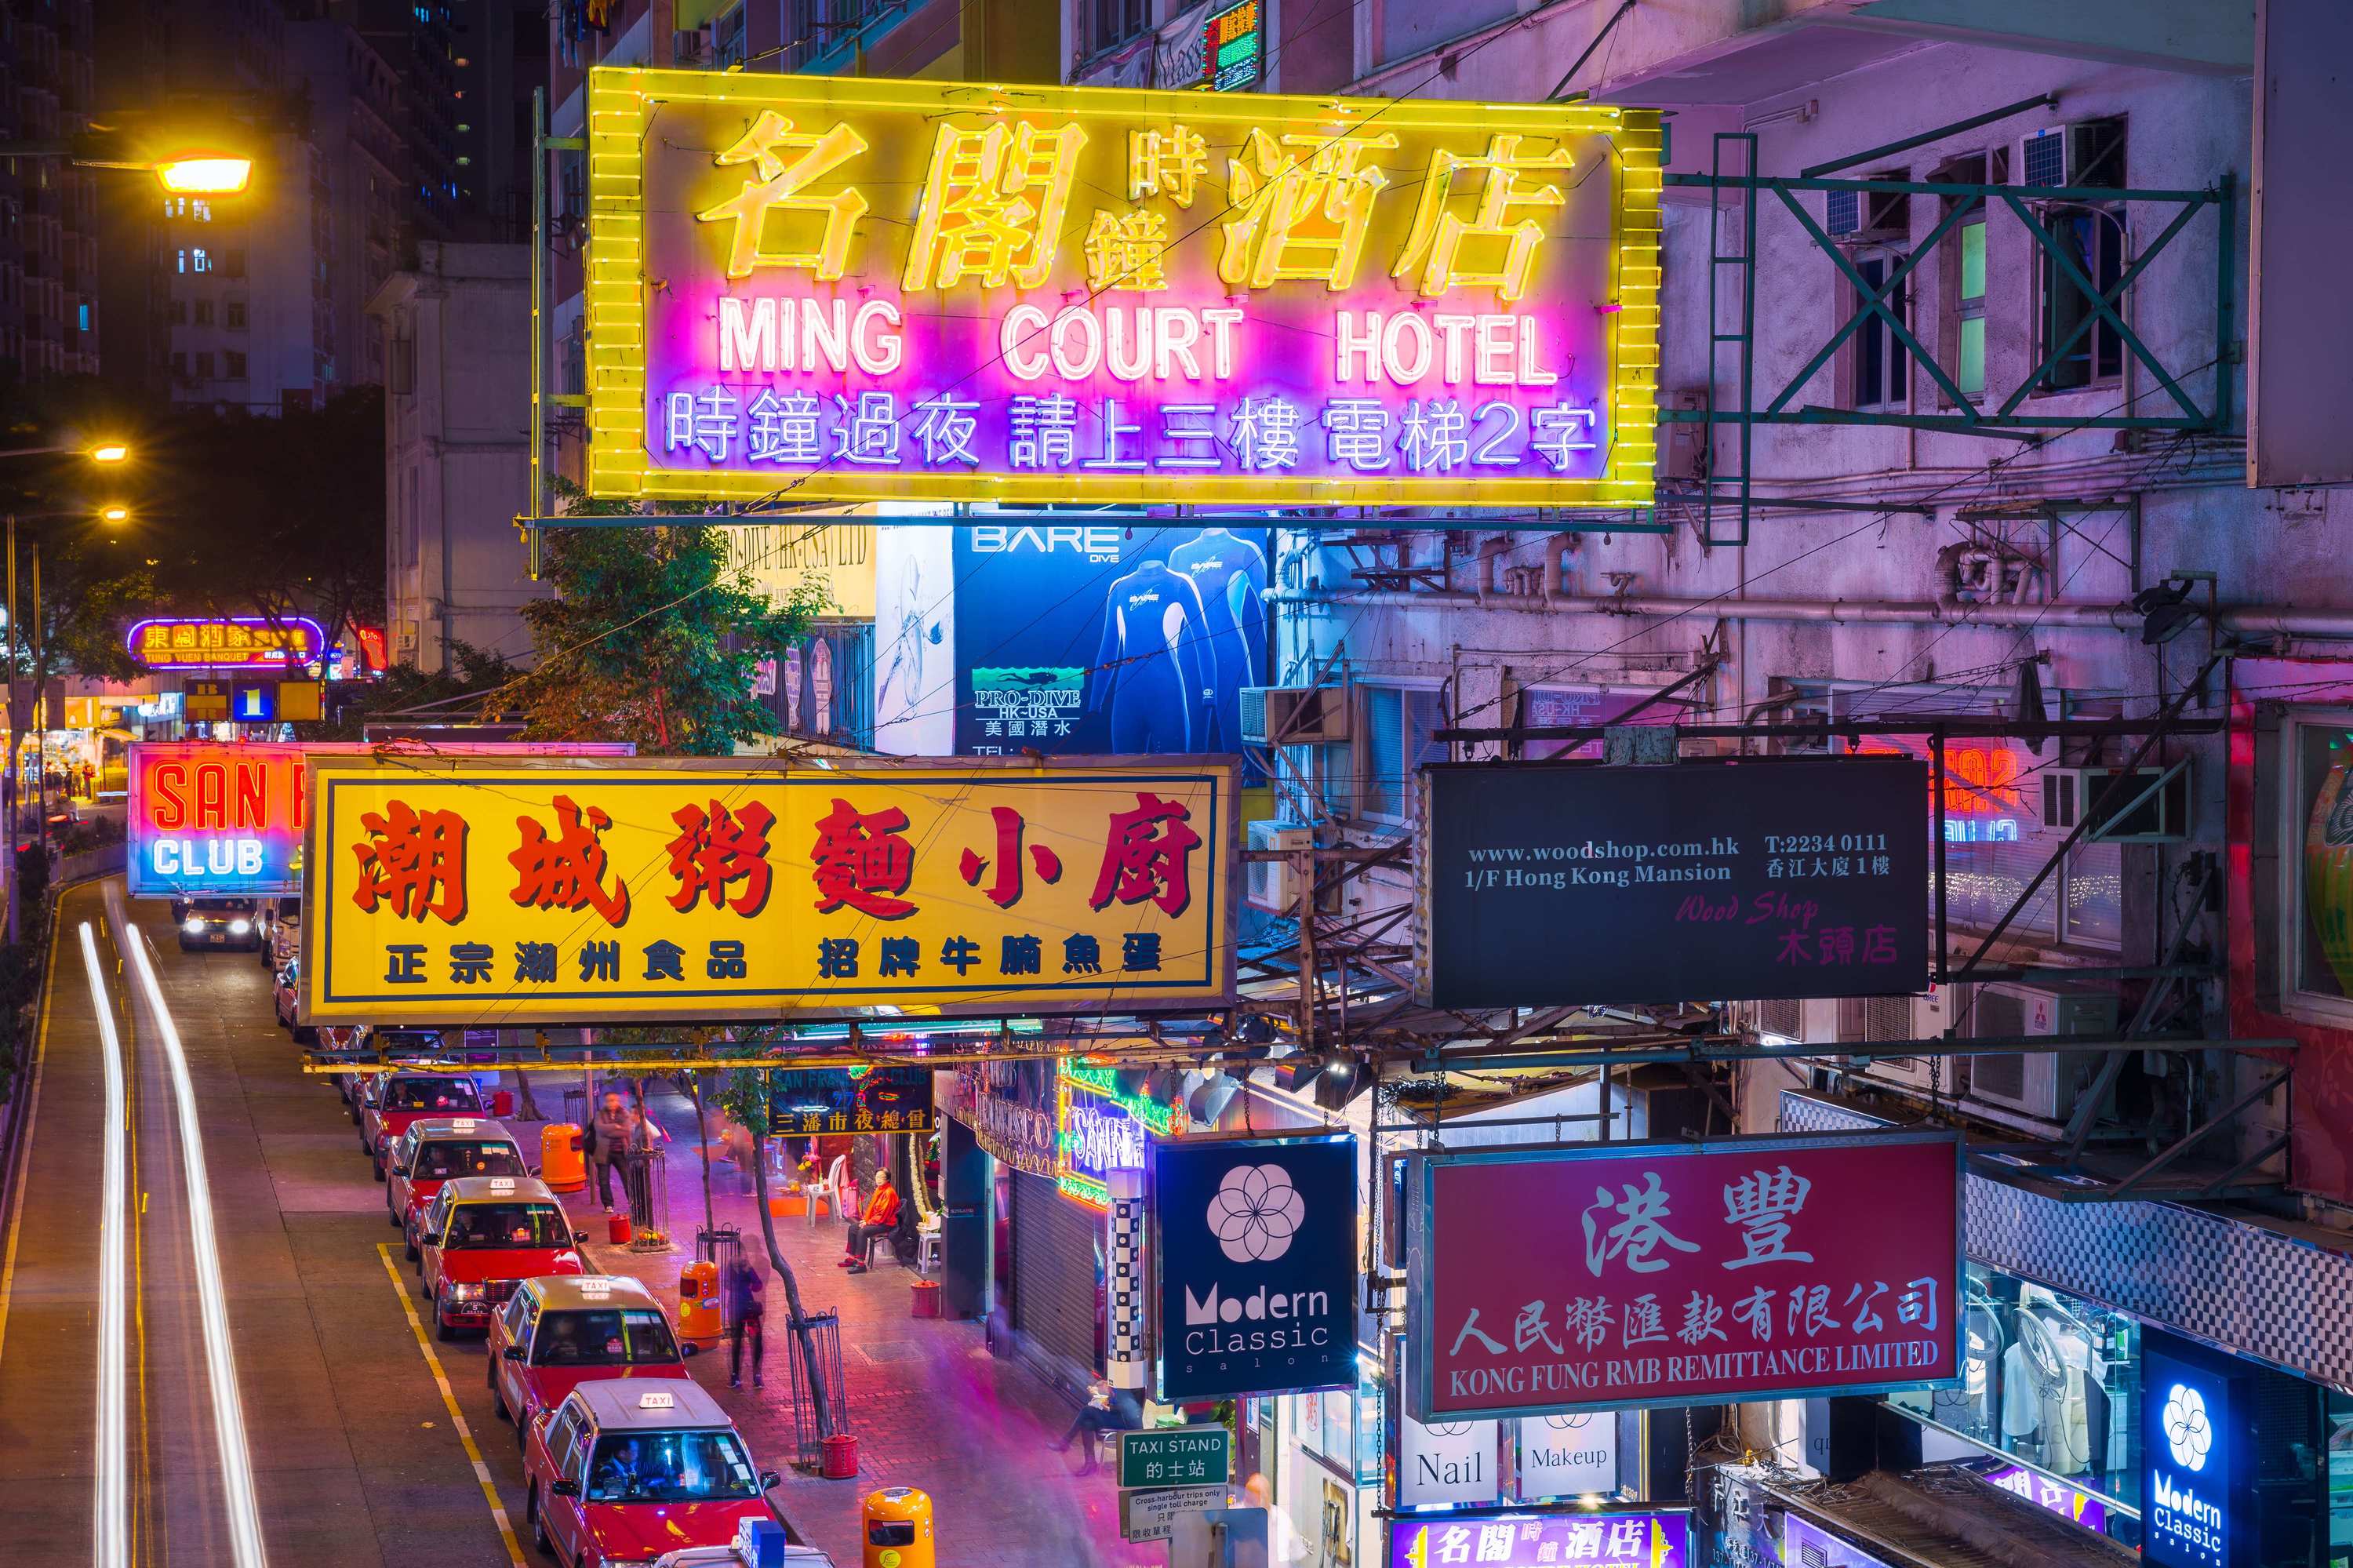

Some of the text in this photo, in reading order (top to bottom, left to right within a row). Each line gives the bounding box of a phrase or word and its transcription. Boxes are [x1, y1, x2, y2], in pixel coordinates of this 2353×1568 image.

[719, 297, 1558, 386] MING COURT HOTEL
[971, 526, 1120, 553] BARE
[1089, 554, 1120, 563] DIVE
[975, 690, 1081, 707] PRO-DIVE
[985, 720, 1071, 737] 美國潛水
[154, 762, 268, 831] SAN
[153, 839, 264, 875] CLUB
[1468, 836, 1740, 864] www.woodshop.com.hk
[1765, 834, 1887, 854] T:2234 0111
[1464, 864, 1732, 892] 1/F Hong Kong Mansion
[1675, 890, 1819, 930] Wood Shop
[1775, 925, 1899, 966] 木頭店
[1580, 1165, 1814, 1279] 港豐
[584, 1280, 609, 1290] TAXI
[1185, 1281, 1329, 1326] Modern
[1185, 1324, 1329, 1356] Classic
[1449, 1340, 1939, 1399] KONG FUNG RMB REMITTANCE LIMITED
[645, 1396, 671, 1405] TAXI
[1130, 1438, 1221, 1454] TAXI STAND
[1531, 1447, 1607, 1469] Makeup
[1146, 1459, 1206, 1479] 的士站
[1417, 1452, 1482, 1486] Nail
[1135, 1489, 1220, 1505] Cross-harbour trips only
[1147, 1501, 1168, 1512] single
[1183, 1499, 1208, 1508] charge
[2154, 1469, 2221, 1530] Modern
[1434, 1524, 1516, 1563] 名閣
[1564, 1519, 1646, 1560] 酒店
[2154, 1510, 2221, 1554] Classic
